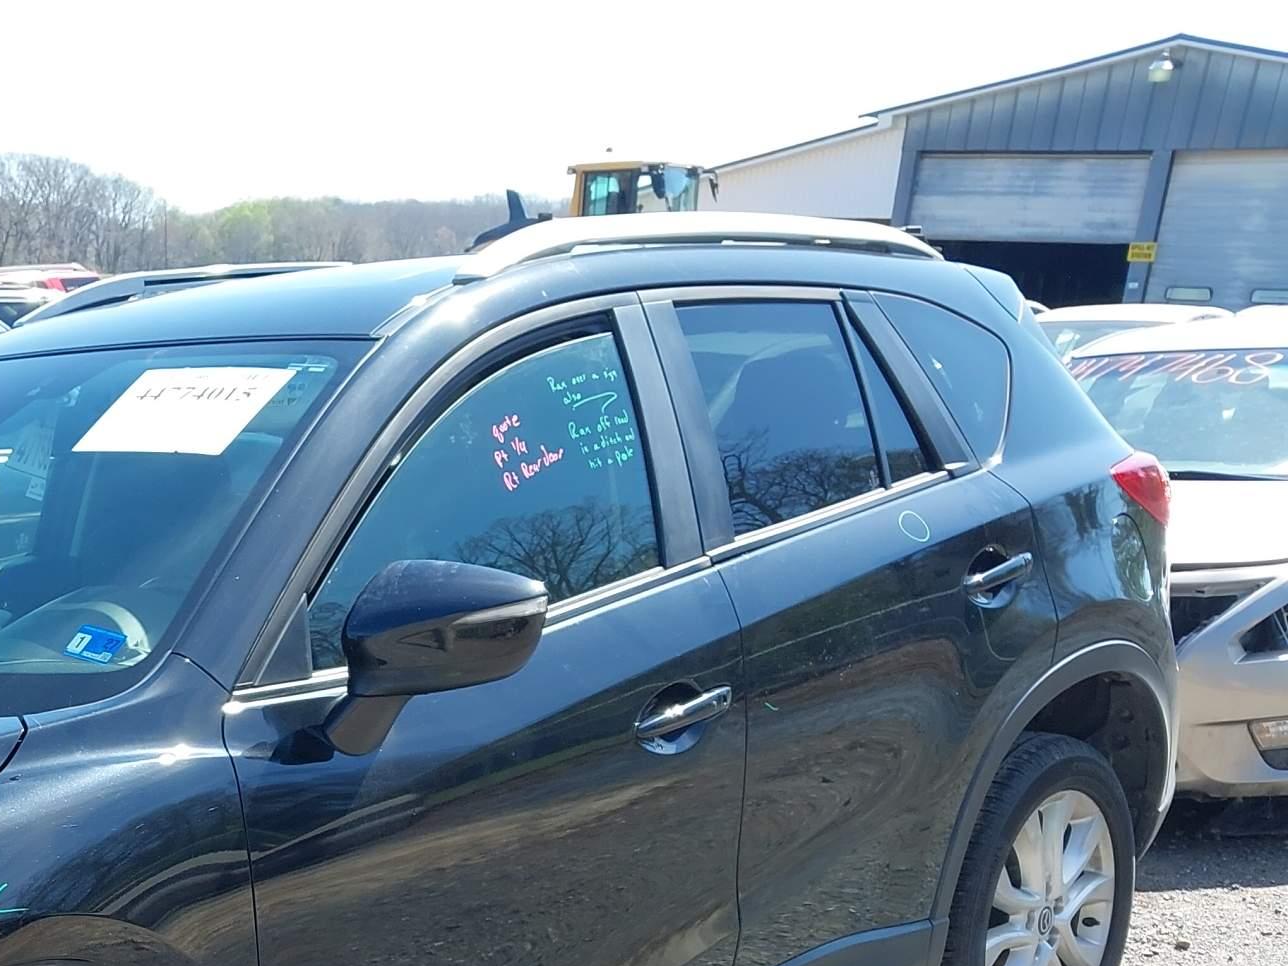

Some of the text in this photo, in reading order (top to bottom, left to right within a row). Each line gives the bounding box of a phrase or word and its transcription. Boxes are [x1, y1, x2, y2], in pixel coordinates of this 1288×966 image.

[546, 376, 567, 393] Ran
[568, 421, 592, 440] Ran
[597, 415, 611, 432] off
